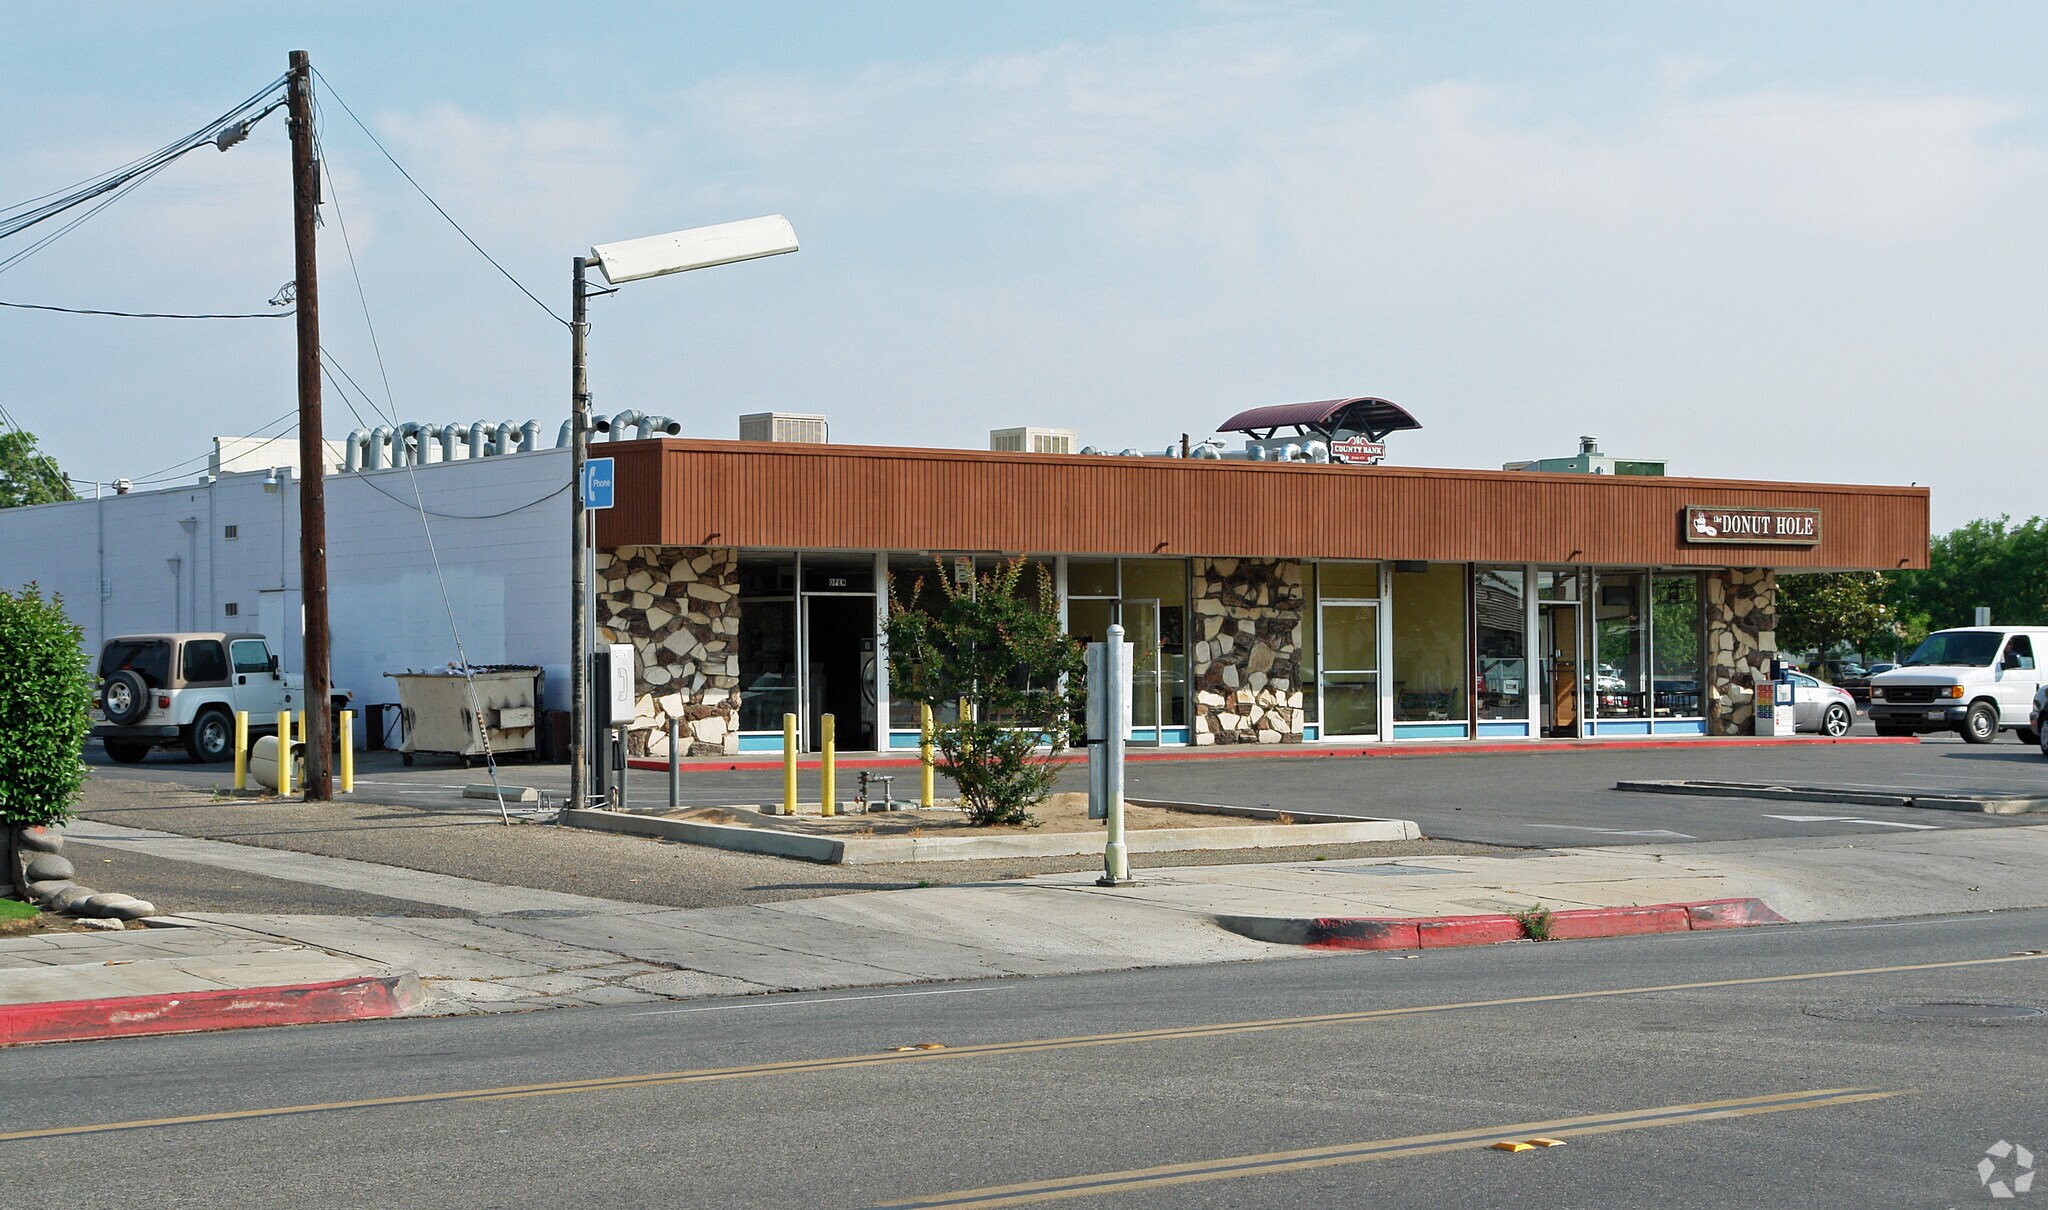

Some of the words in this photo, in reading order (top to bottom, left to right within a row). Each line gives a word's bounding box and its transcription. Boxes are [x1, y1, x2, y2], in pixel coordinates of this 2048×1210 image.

[1713, 515, 1721, 523] the
[1721, 515, 1771, 534] DONUT
[1775, 516, 1813, 535] HOLE
[829, 578, 847, 587] OPEN
